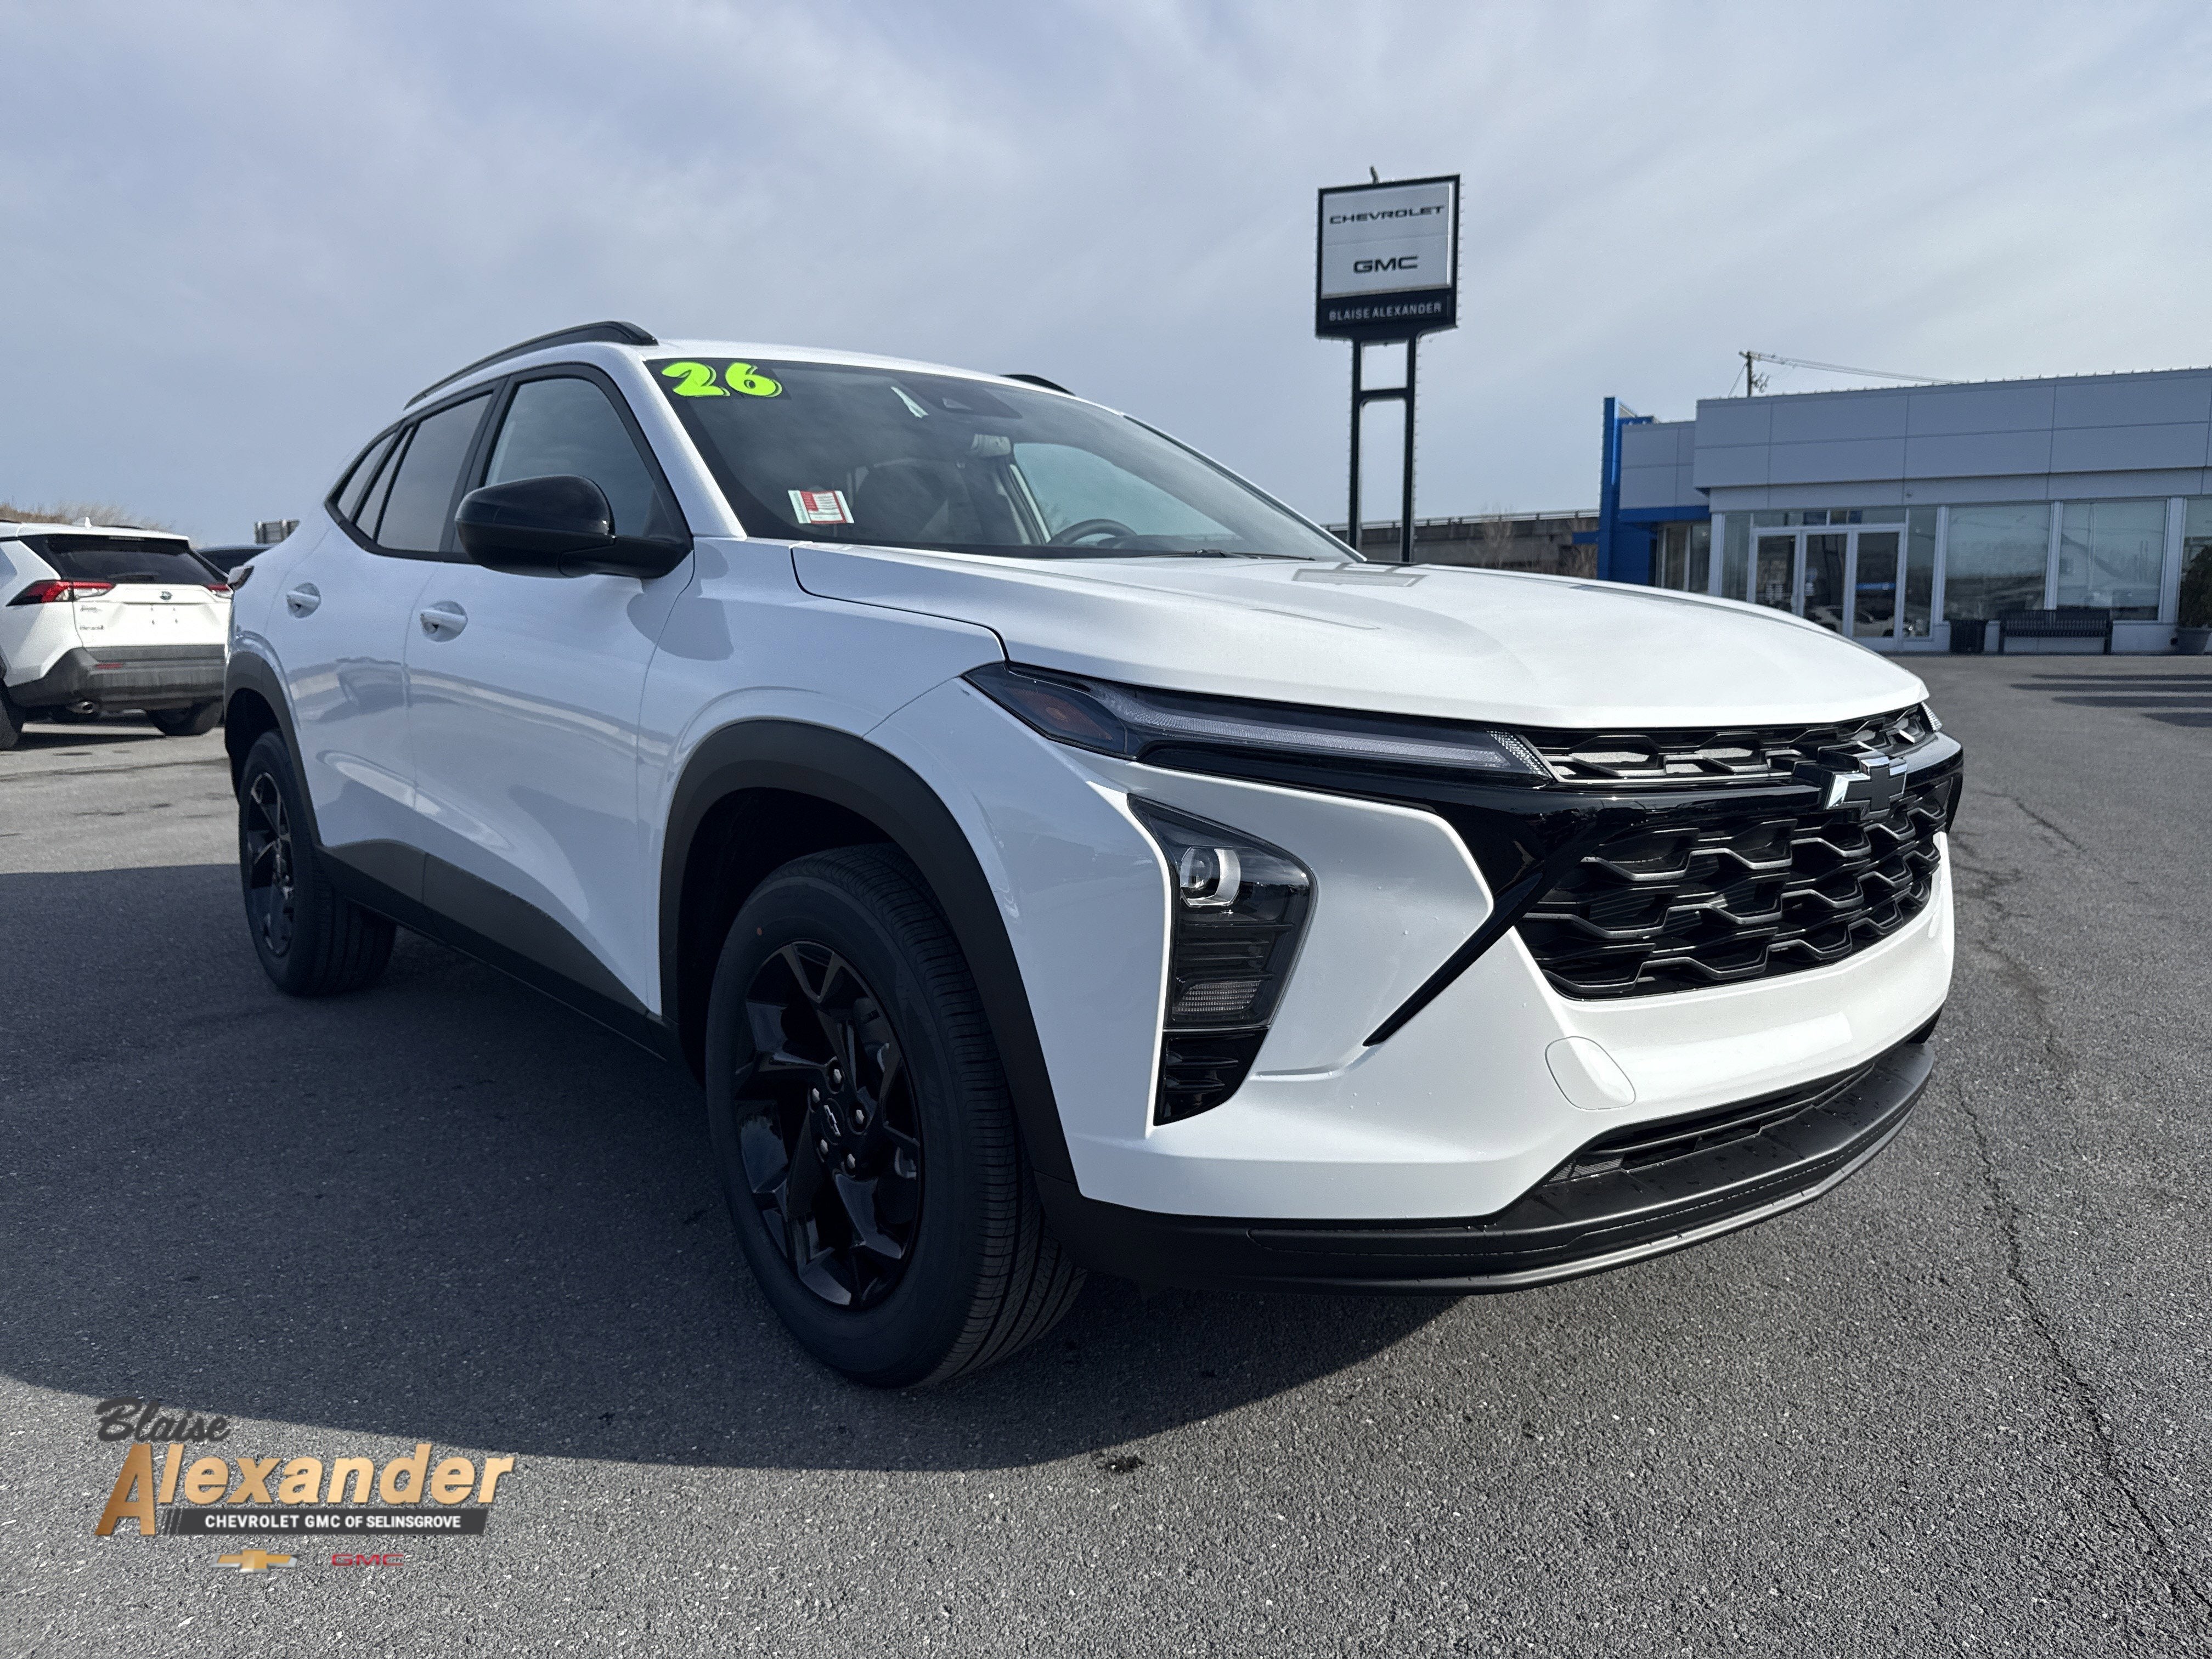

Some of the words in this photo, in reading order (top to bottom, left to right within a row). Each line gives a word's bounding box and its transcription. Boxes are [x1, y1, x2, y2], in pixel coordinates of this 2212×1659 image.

[1330, 206, 1444, 224] CHEVROLET
[1353, 256, 1418, 273] GMC
[1329, 307, 1370, 321] BLAISE
[1372, 302, 1442, 318] ALEXANDER
[662, 362, 782, 397] 26
